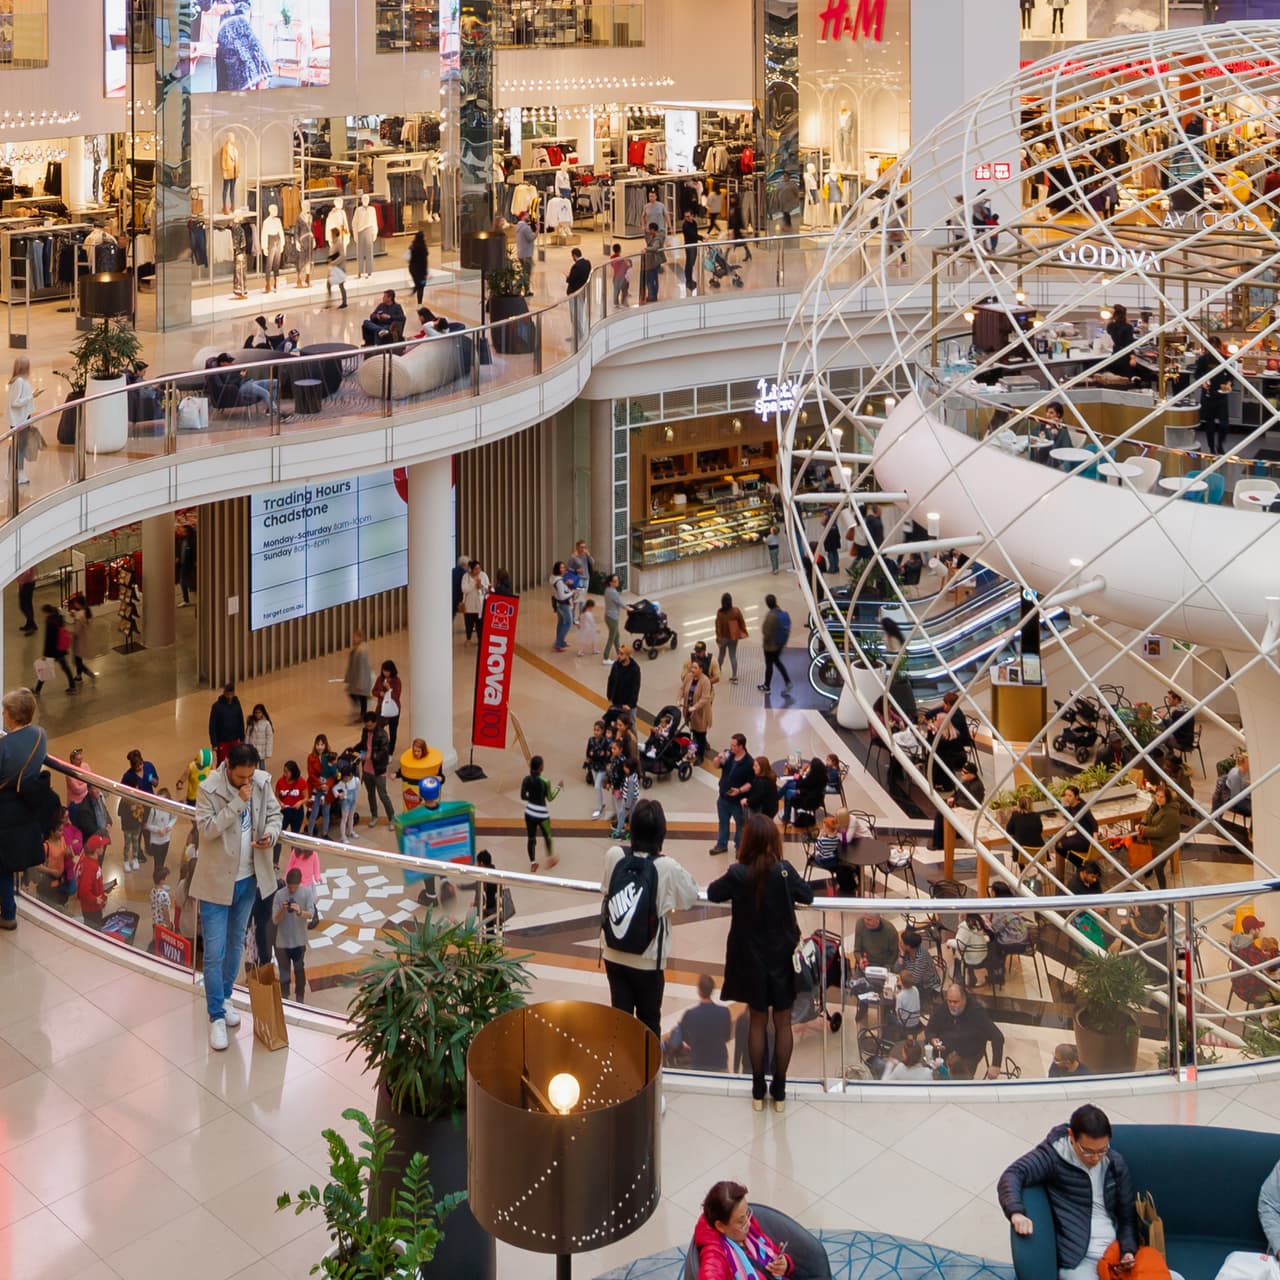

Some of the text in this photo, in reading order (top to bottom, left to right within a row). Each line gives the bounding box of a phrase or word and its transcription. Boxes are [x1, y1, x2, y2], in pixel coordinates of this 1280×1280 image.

[1059, 244, 1161, 272] GODIVA
[263, 481, 351, 511] Trading Hours
[263, 503, 329, 528] Chadstone
[263, 546, 293, 562] Sunday
[483, 634, 509, 706] nova
[608, 881, 637, 923] NIKE
[163, 941, 181, 963] WIN
